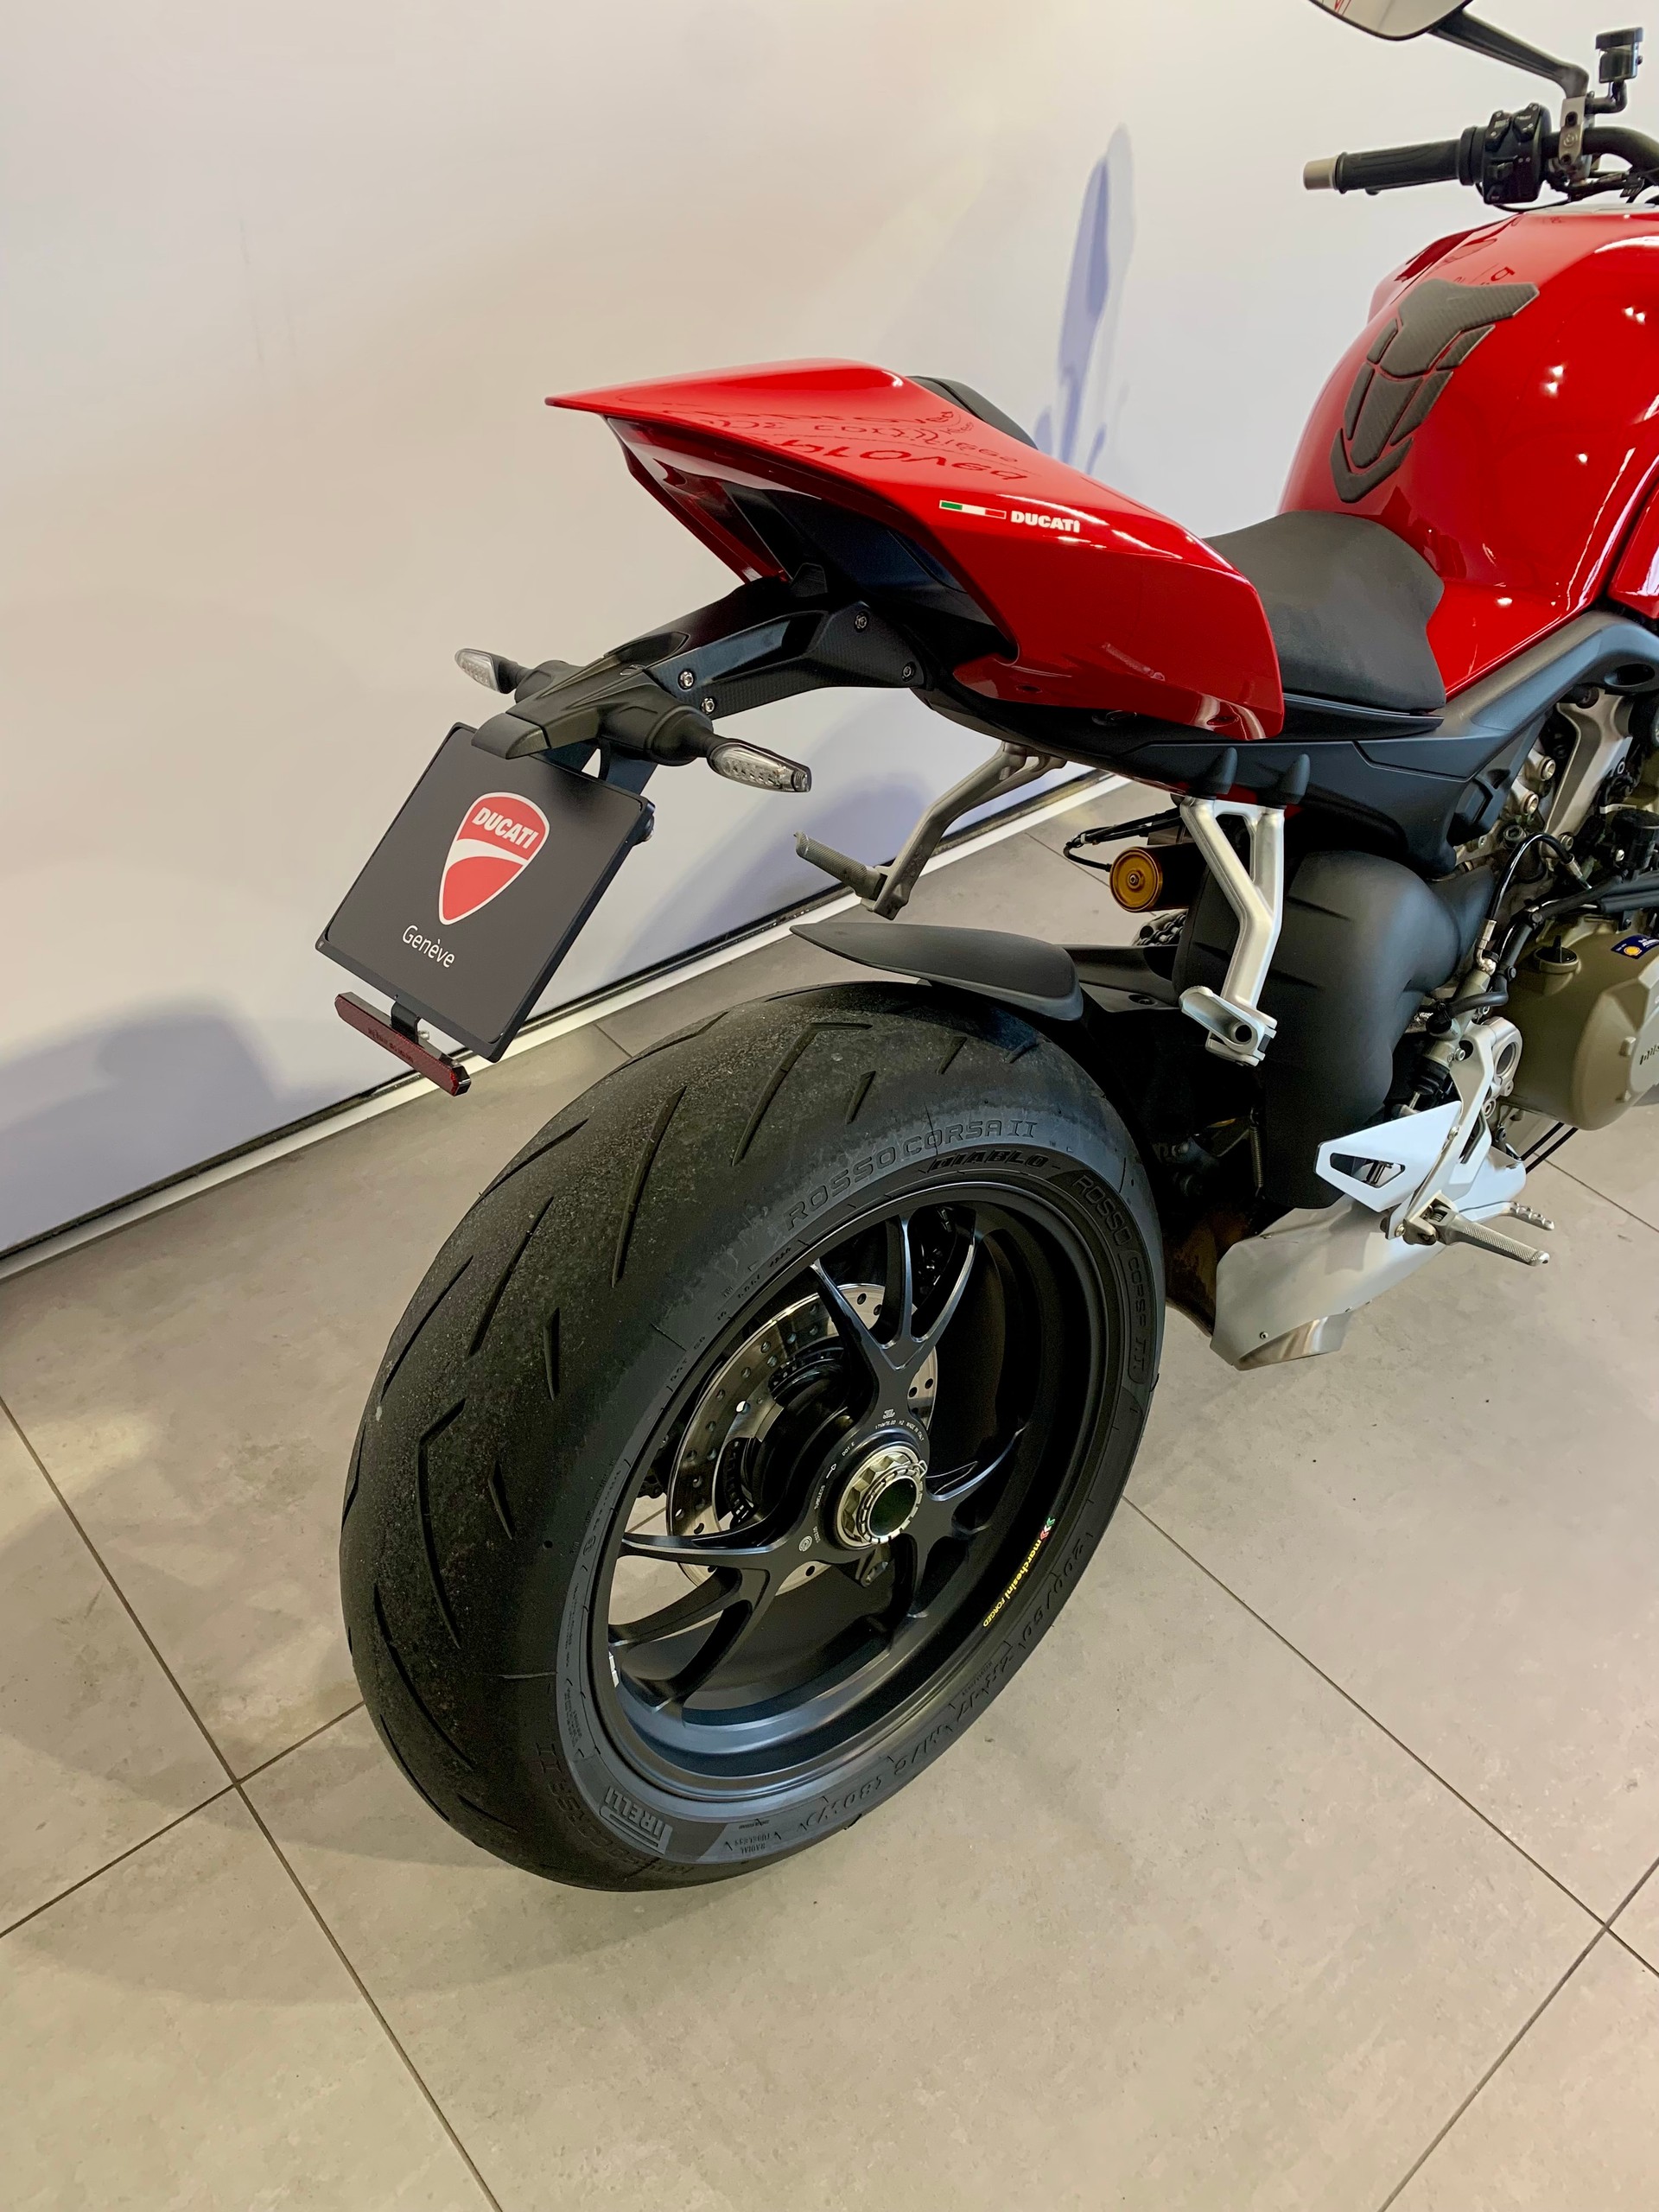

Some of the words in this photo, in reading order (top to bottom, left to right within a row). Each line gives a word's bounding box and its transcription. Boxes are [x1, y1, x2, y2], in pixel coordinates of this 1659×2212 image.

[1010, 510, 1080, 533] DUCATI
[472, 806, 540, 849] DUCATI
[402, 924, 455, 969] Genève
[782, 1146, 897, 1231] ROSSO
[902, 1119, 1002, 1156] CORSA
[927, 1148, 1050, 1173] DIABLO
[1072, 1174, 1132, 1246] ROSSO
[1004, 1539, 1042, 1599] marchesini
[982, 1597, 1006, 1627] FORGED
[599, 1785, 674, 1856] PIRELLI
